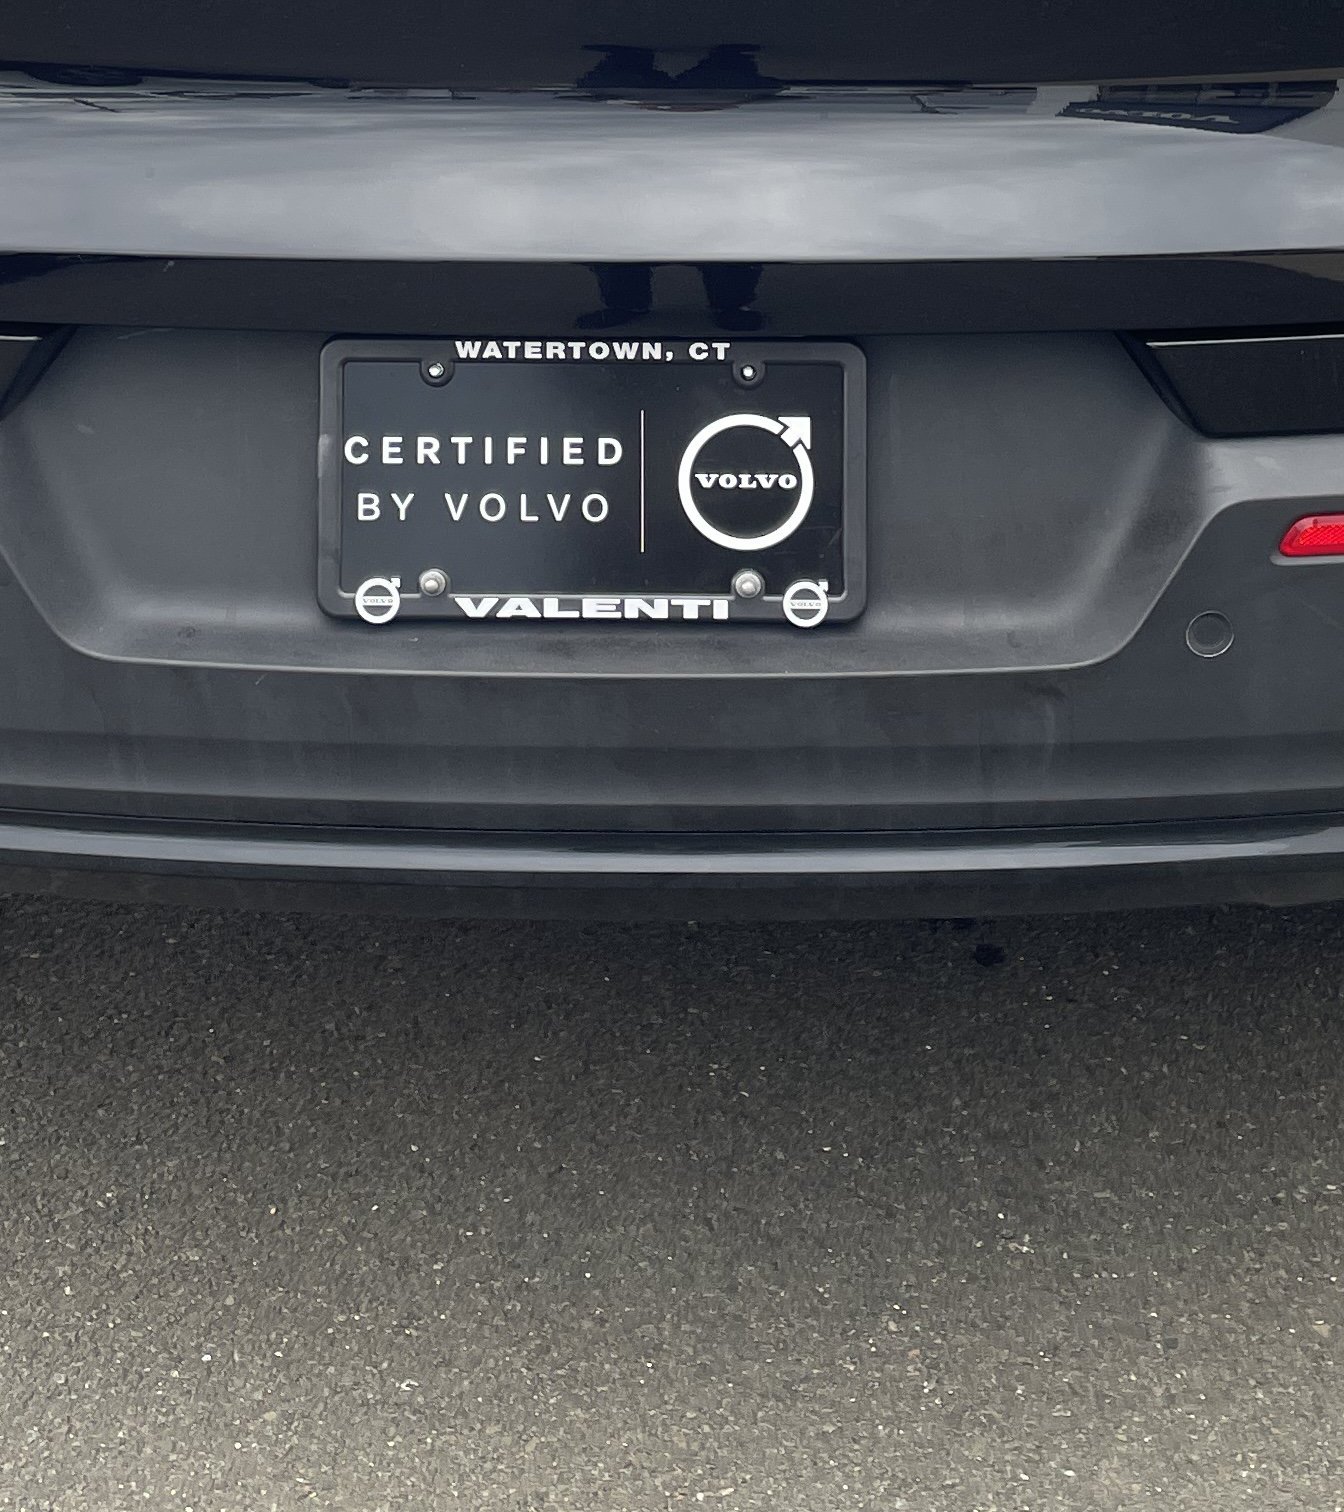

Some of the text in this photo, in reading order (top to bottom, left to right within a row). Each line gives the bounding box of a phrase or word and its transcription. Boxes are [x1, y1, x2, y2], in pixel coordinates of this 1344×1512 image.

[455, 340, 732, 363] WATERTOWN, CT
[344, 436, 624, 465] CERTIFIED
[694, 472, 798, 490] VOLVO
[357, 492, 610, 522] BY VOLVO
[454, 596, 729, 620] VALENTI
